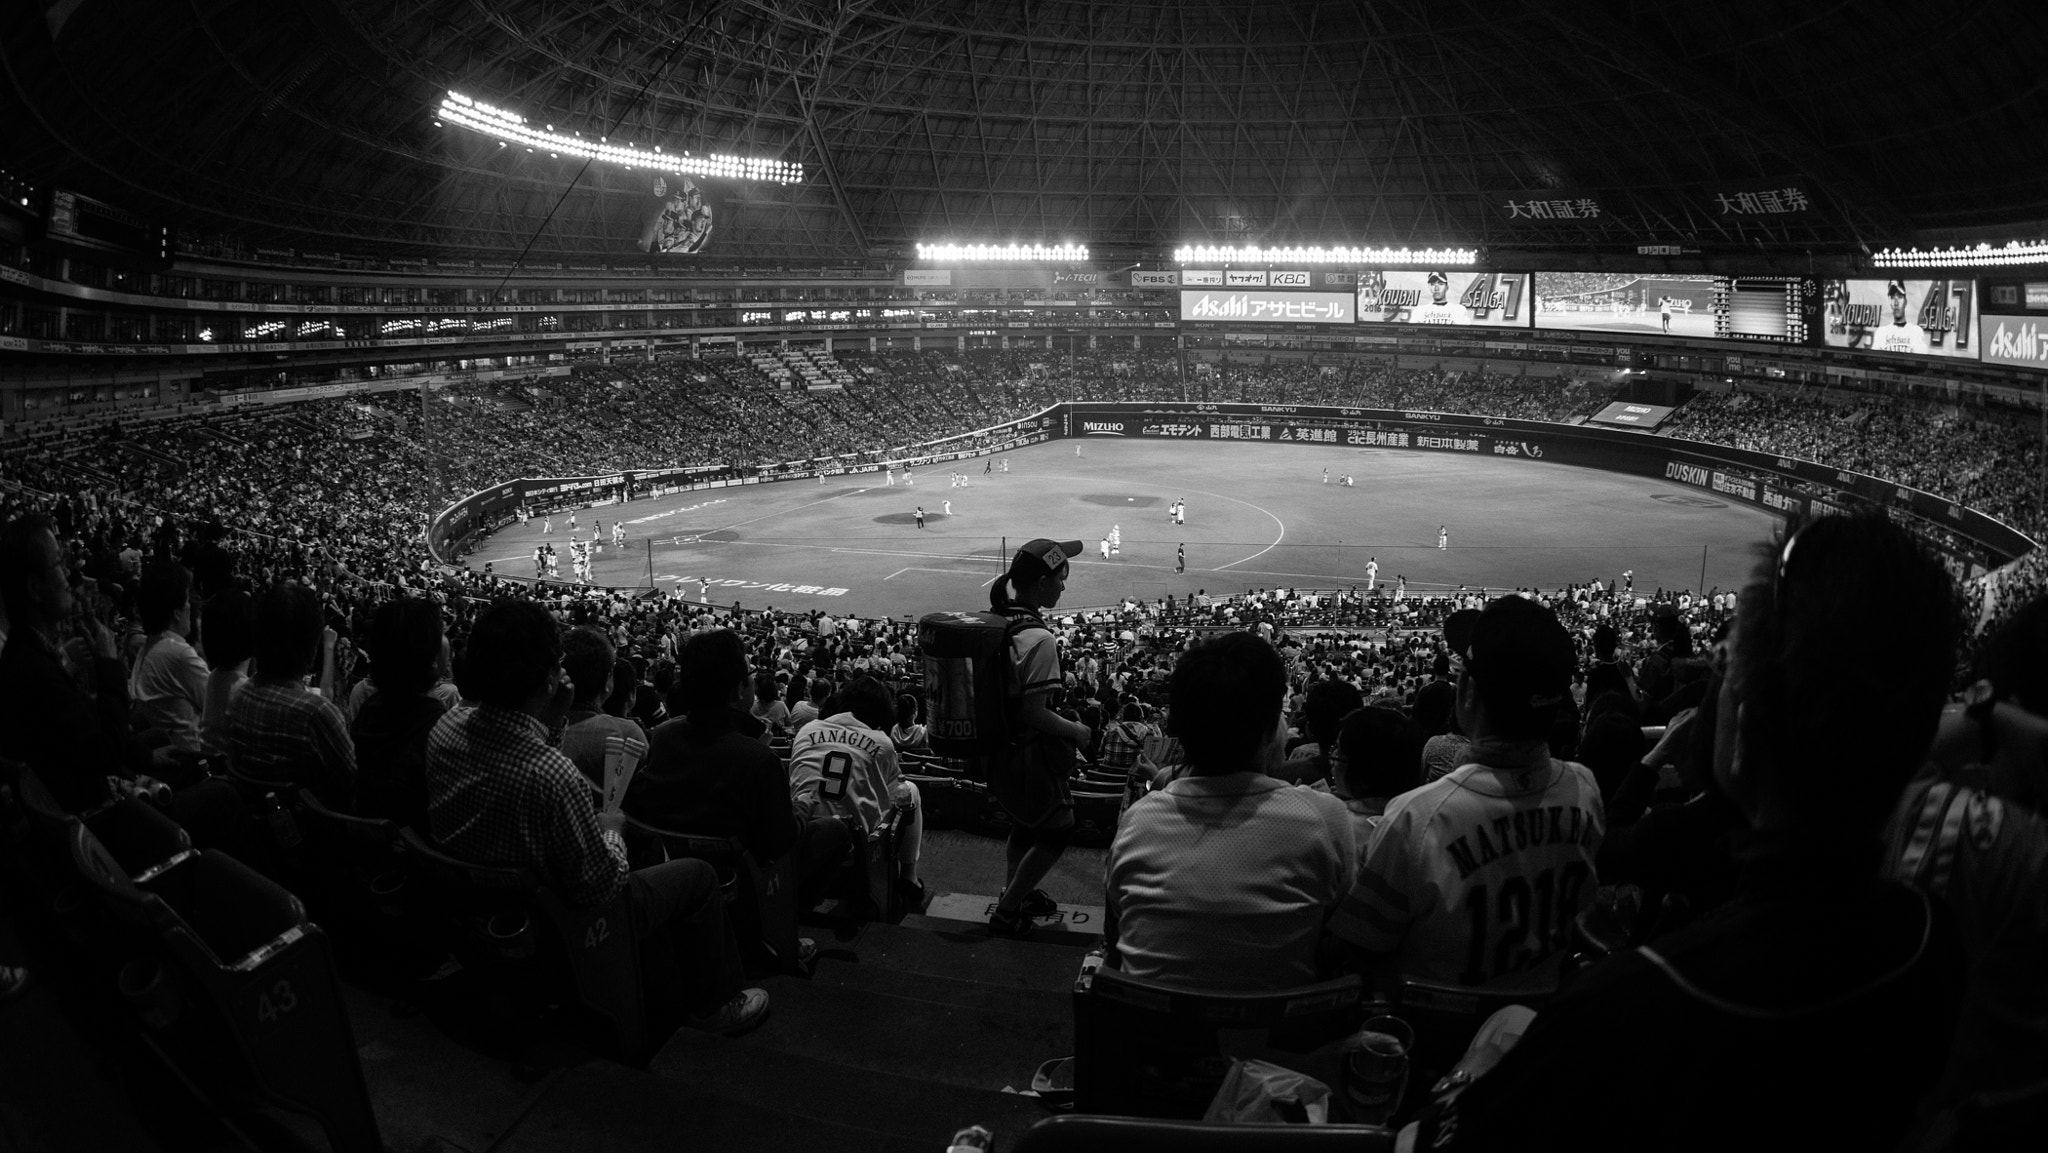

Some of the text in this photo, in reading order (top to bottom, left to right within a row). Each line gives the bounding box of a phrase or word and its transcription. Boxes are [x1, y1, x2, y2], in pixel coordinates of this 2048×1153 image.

[1503, 198, 1601, 219] 大和証券
[1714, 188, 1808, 215] 大和証券
[1142, 273, 1165, 284] FBS
[1229, 273, 1264, 284] ヤフオク!
[1273, 273, 1307, 285] KBC
[1376, 289, 1421, 307] KOUDAI
[1459, 272, 1524, 320] 47
[1464, 290, 1504, 309] SENGA
[1192, 294, 1346, 319] Asahi アサヒビール
[1364, 304, 1382, 313] 2016
[1840, 303, 1882, 327] KOUDAI
[1918, 280, 1973, 351] 47
[1922, 305, 1957, 331] SENGA
[1990, 321, 2037, 361] Asahi
[1616, 346, 1631, 356] you
[1405, 412, 1441, 421] SANKYU
[1083, 421, 1125, 432] MIZUHO
[1160, 424, 1202, 437] エモテント
[1210, 424, 1271, 440] 西部電気工業
[1295, 427, 1337, 443] 英進館
[1366, 430, 1410, 447] 長州産業
[1416, 435, 1479, 452] 新日本製薬
[1665, 461, 1709, 487] DUSKIN
[1723, 481, 1756, 501] 住友不動産
[1048, 551, 1062, 565] 23
[808, 730, 882, 758] YANAGITA
[819, 750, 853, 801] 9
[766, 873, 780, 896] 41
[584, 916, 610, 950] 42
[257, 979, 298, 1023] 43
